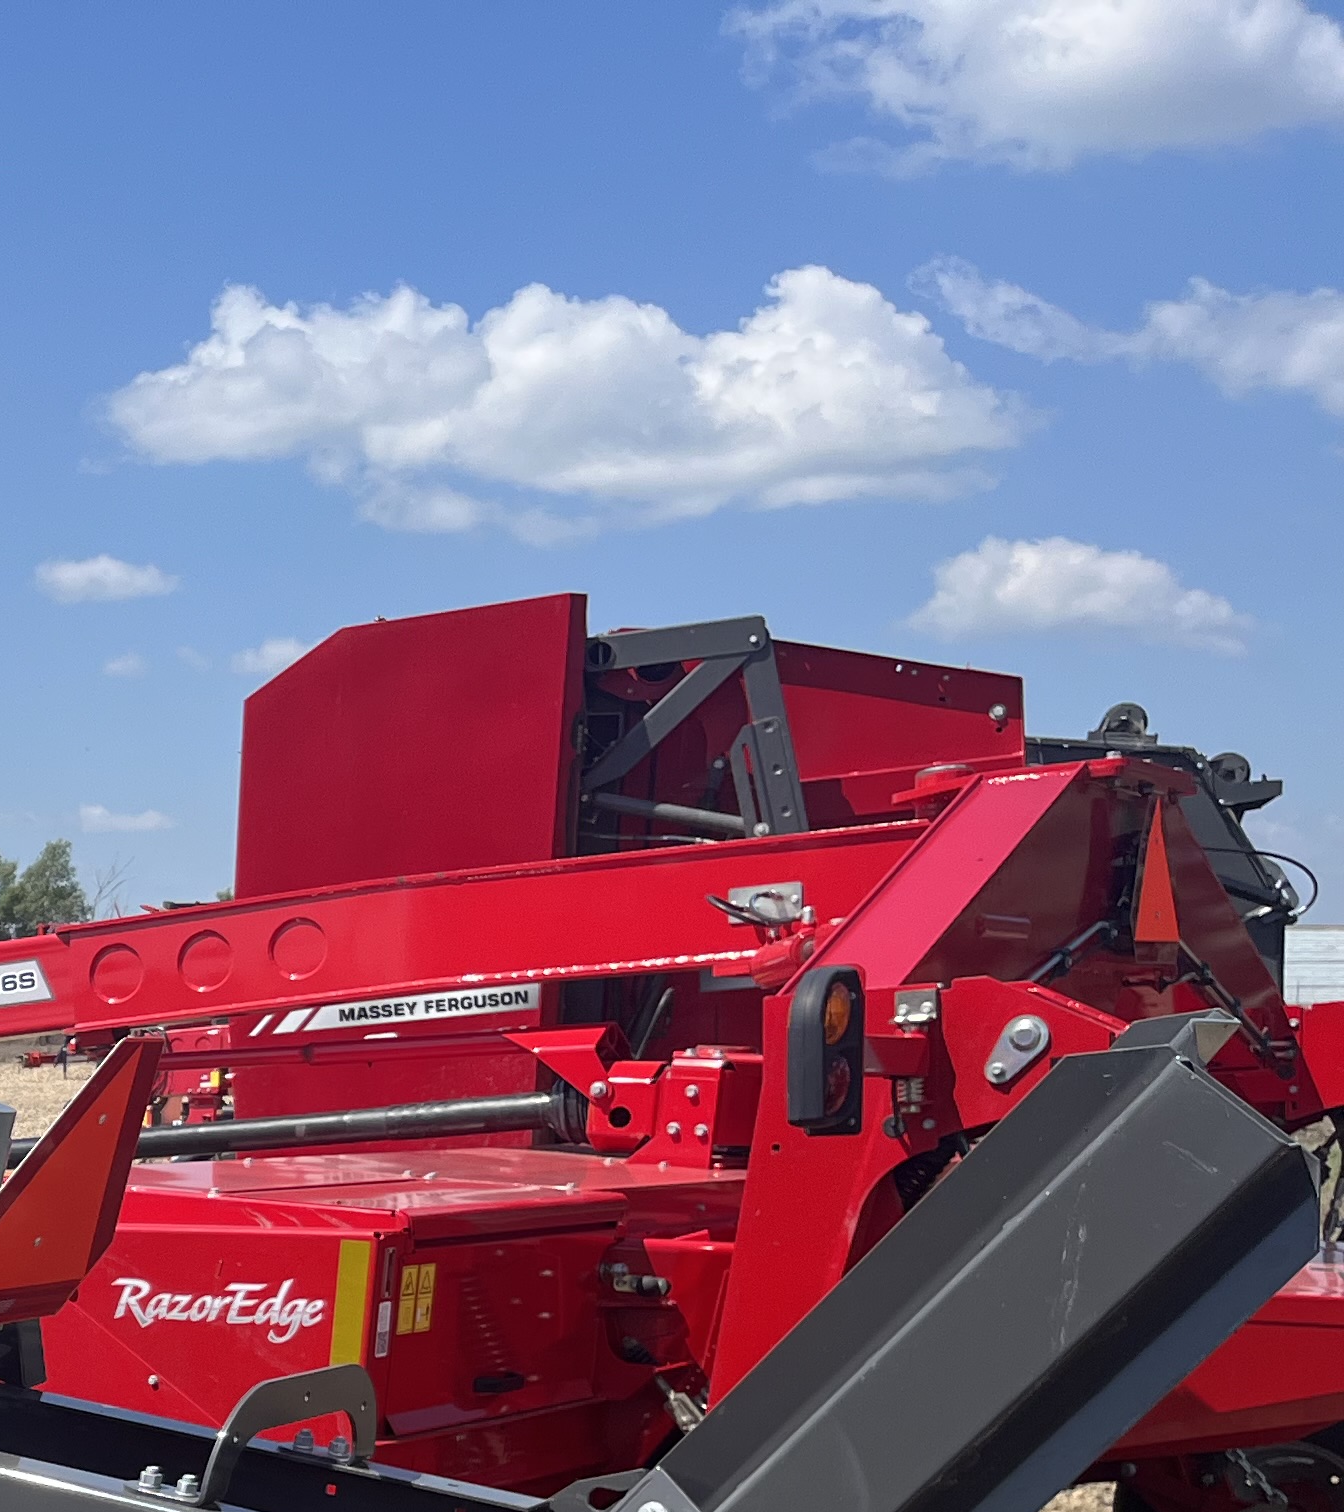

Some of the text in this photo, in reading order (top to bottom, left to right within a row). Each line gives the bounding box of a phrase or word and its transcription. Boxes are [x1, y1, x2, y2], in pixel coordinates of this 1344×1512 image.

[338, 989, 529, 1023] MASSEY FERGUSON
[111, 1276, 326, 1344] RazorEdge
